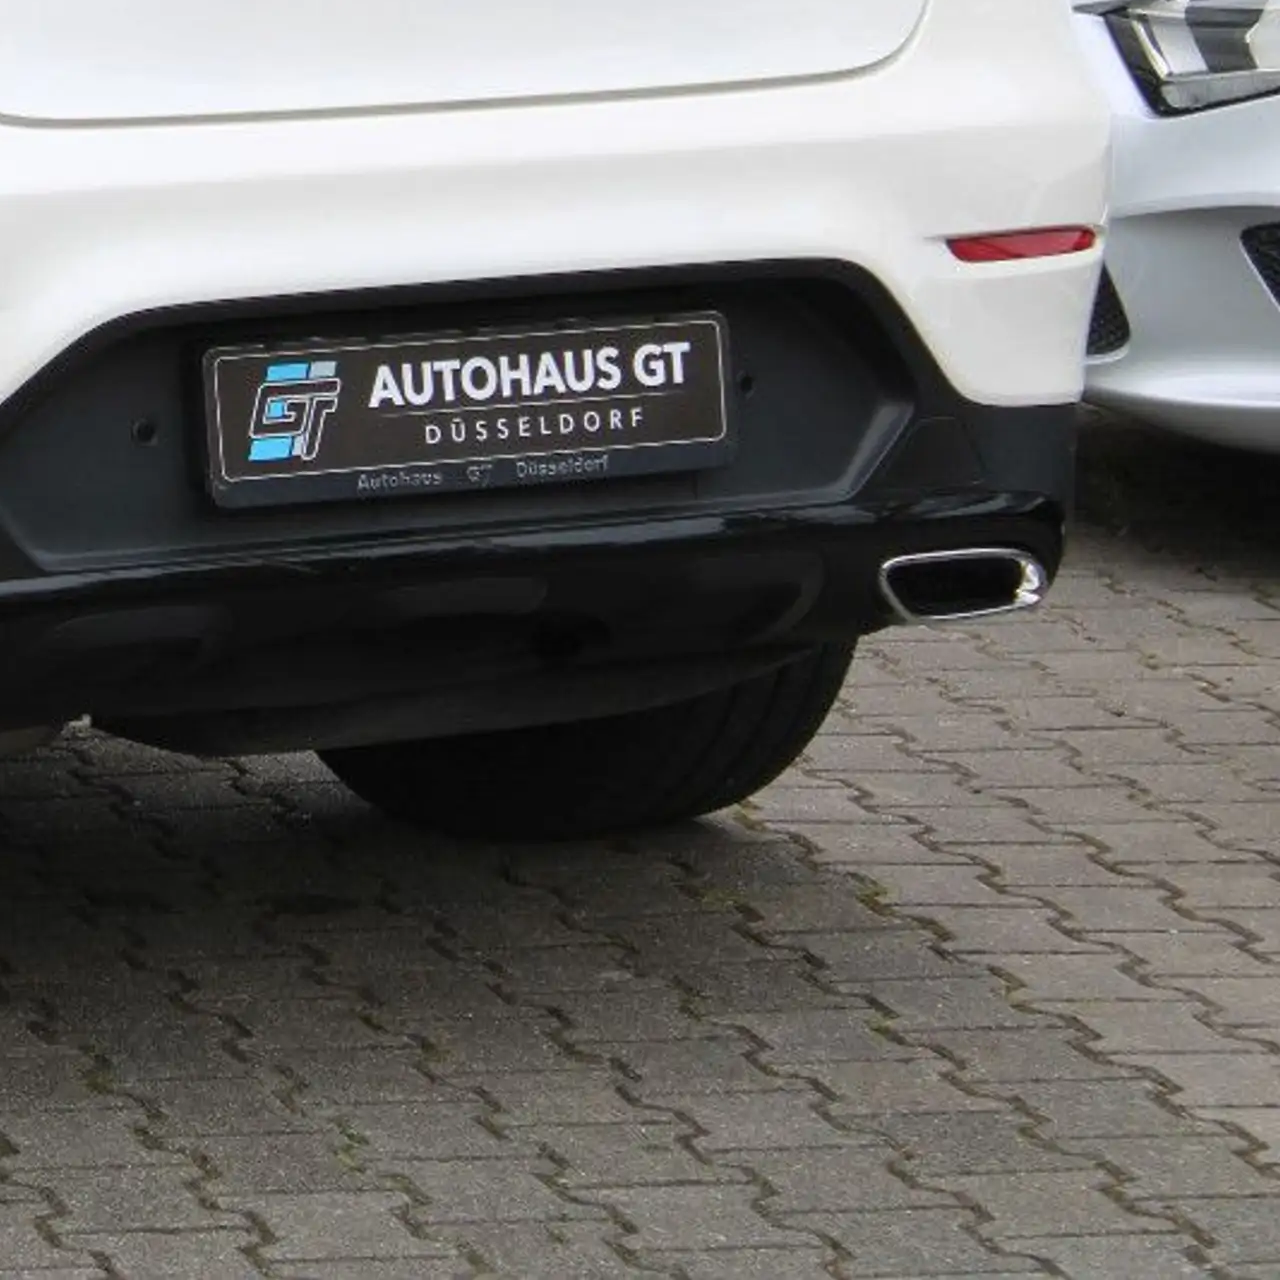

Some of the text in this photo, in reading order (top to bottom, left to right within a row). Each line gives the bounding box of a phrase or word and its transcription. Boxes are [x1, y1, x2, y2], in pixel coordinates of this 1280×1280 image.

[368, 341, 690, 409] AUTOHAUS GT
[425, 407, 644, 445] DÜSSELDORF
[357, 471, 443, 491] Autohaus
[516, 453, 609, 479] Düsseldorf
